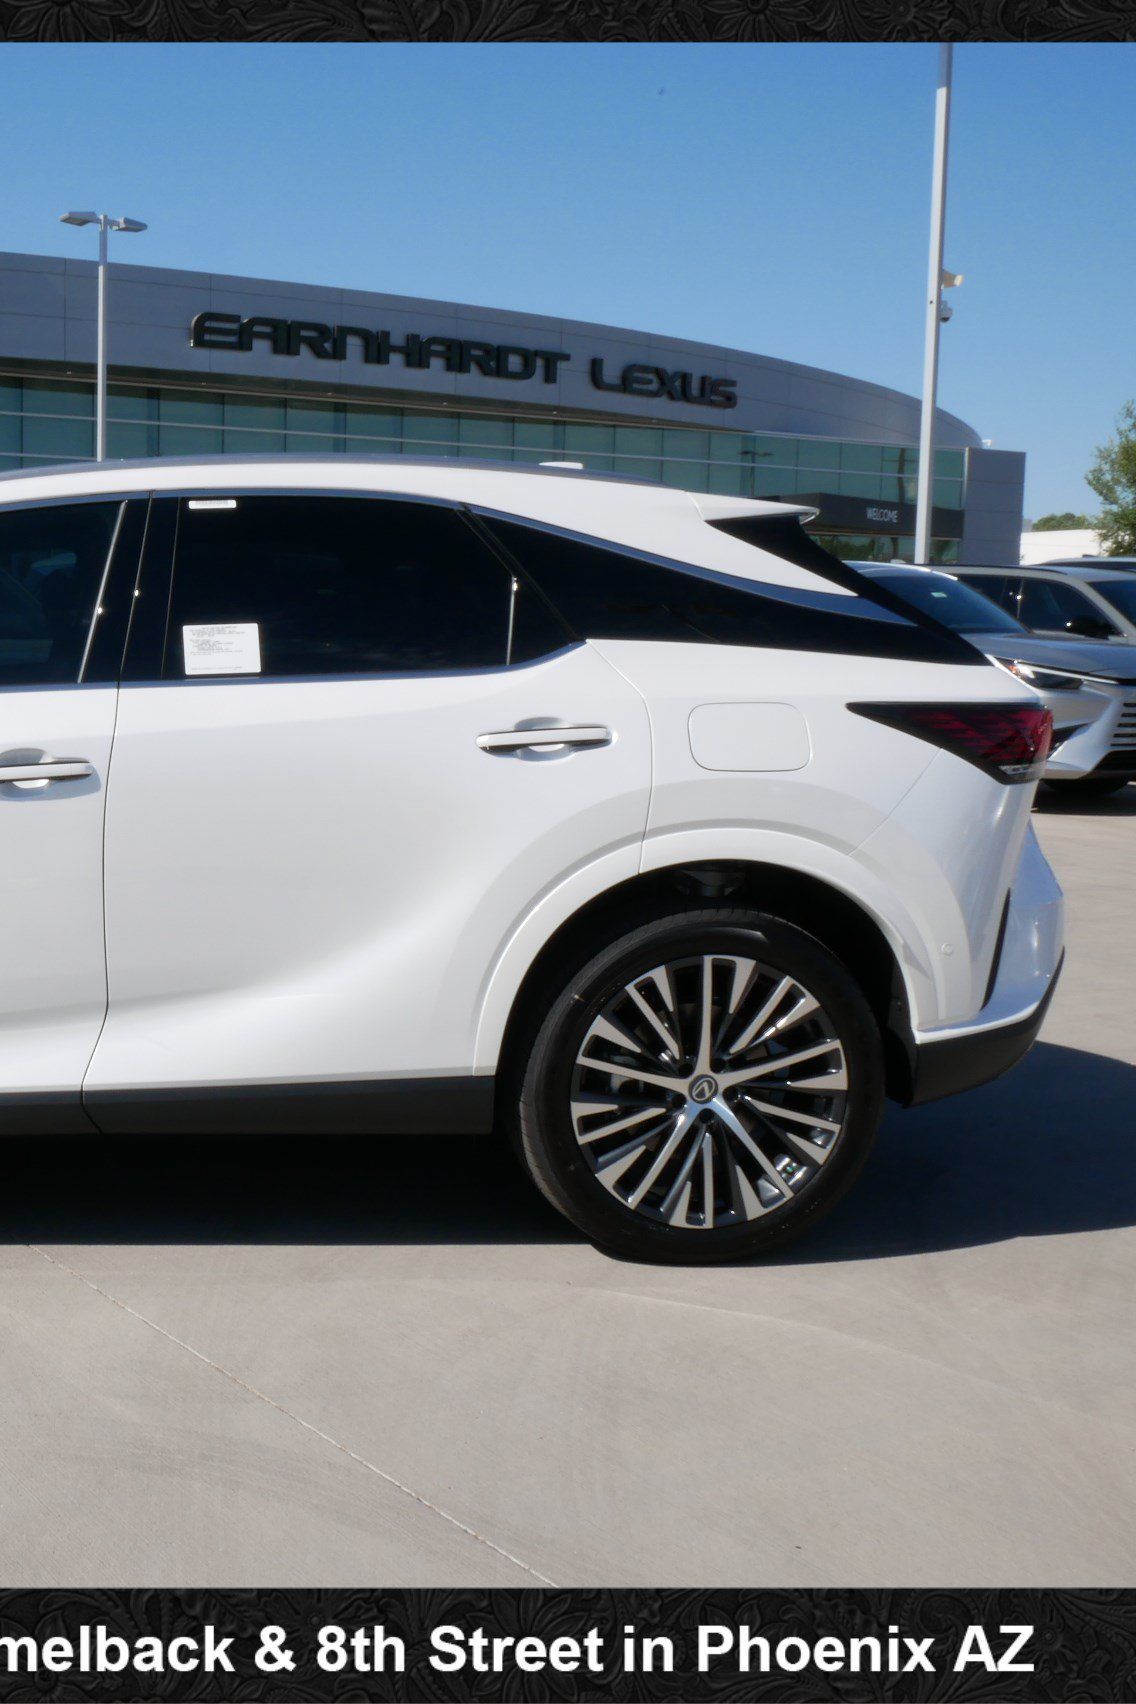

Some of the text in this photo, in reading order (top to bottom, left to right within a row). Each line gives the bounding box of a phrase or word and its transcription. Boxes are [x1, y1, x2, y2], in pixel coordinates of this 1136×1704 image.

[191, 311, 738, 409] EARNHARDT LEXUS
[866, 507, 898, 523] WELCOME
